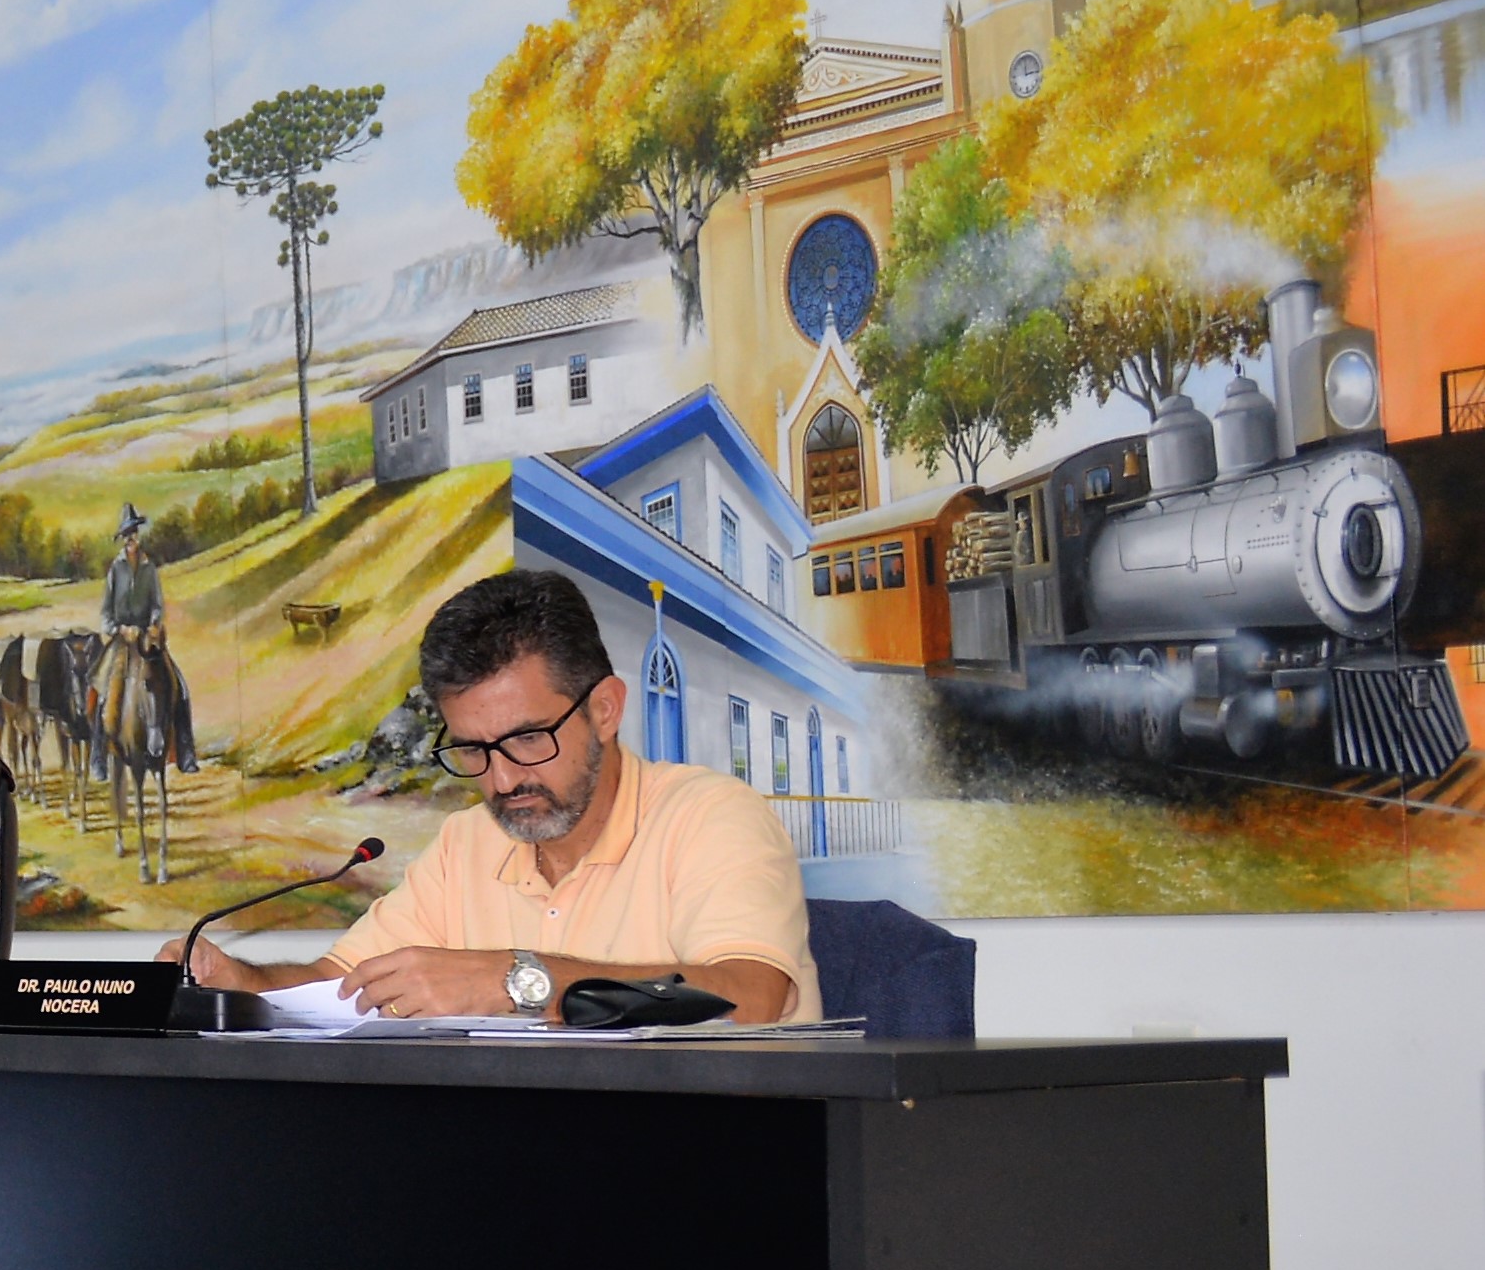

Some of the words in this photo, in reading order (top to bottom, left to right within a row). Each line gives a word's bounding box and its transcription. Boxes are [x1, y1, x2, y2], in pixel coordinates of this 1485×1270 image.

[17, 978, 40, 993] DR.
[43, 979, 92, 994] PAULO
[92, 979, 135, 995] NUNO
[40, 998, 100, 1014] NOCERA
